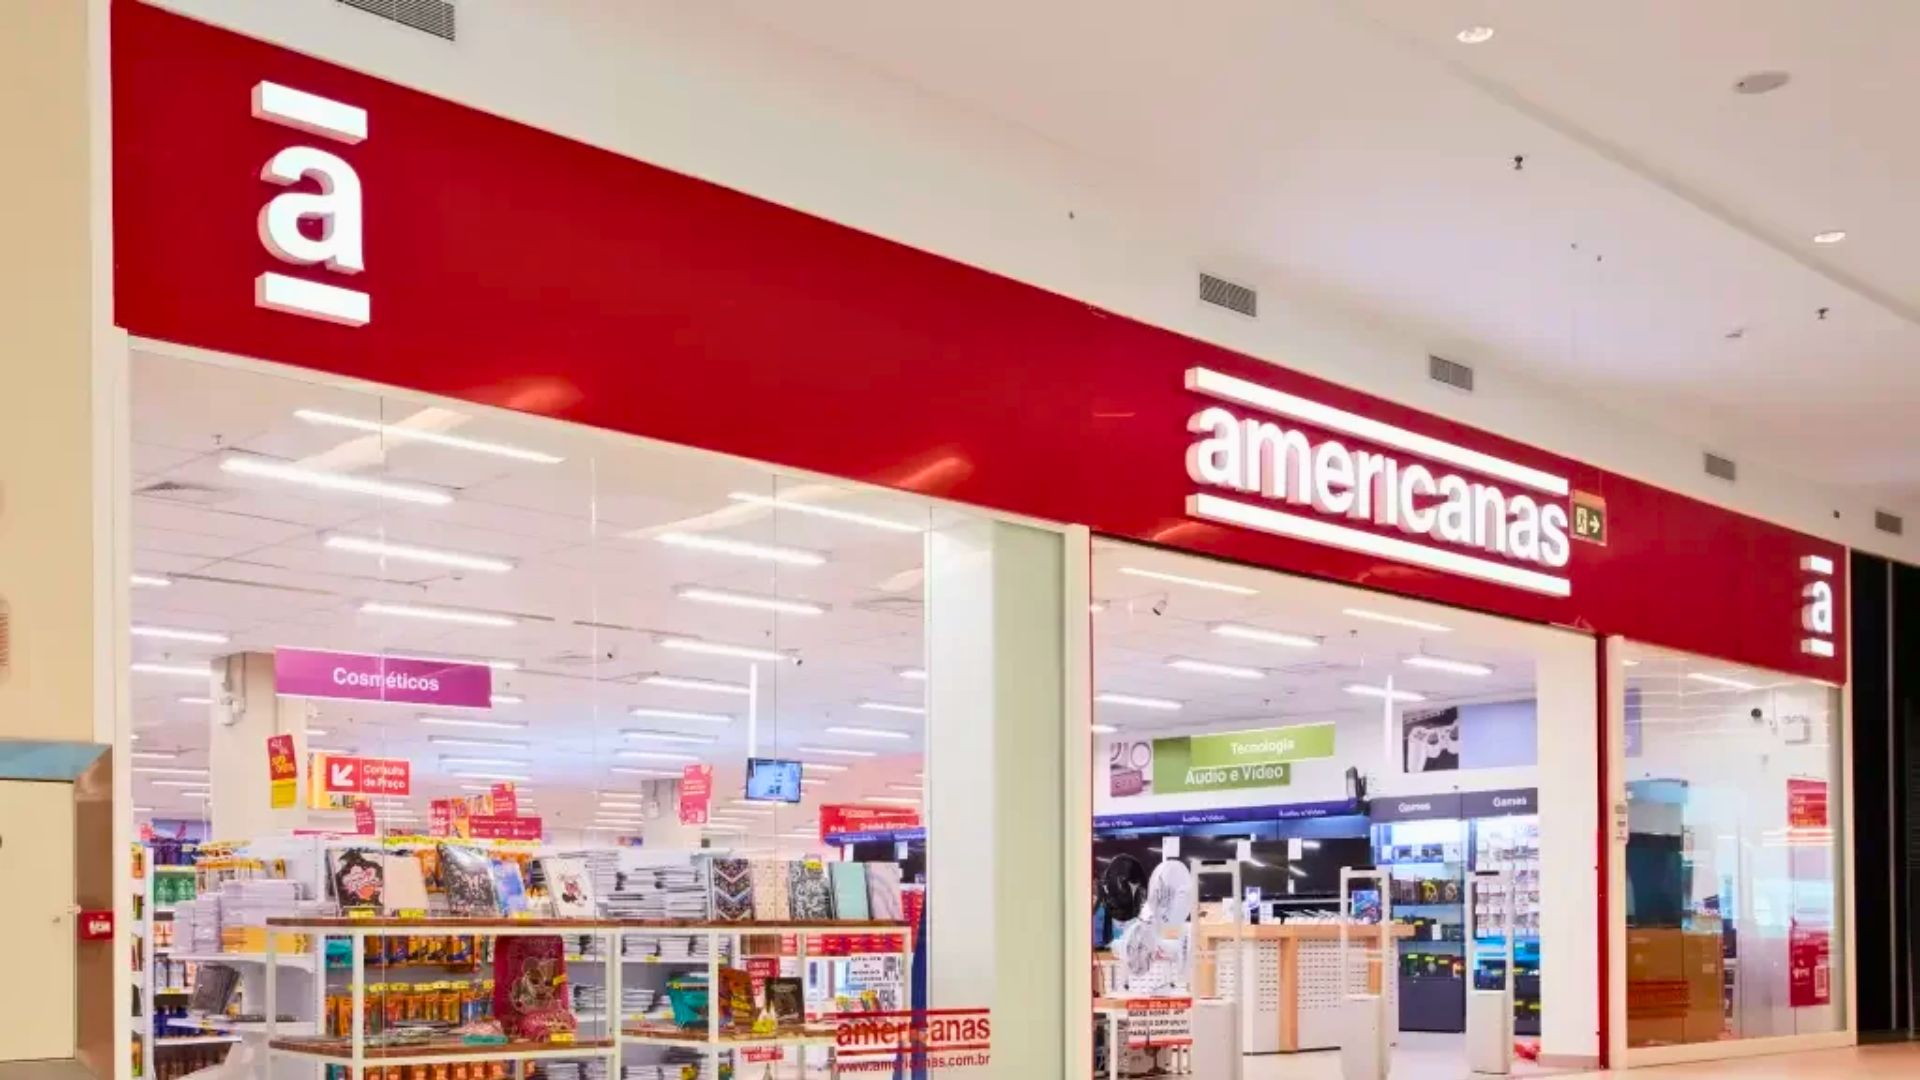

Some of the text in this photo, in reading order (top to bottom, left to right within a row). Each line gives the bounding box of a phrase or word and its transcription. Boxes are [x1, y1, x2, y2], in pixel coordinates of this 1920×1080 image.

[257, 146, 365, 276] a
[1185, 406, 1570, 567] americanas
[1801, 581, 1832, 633] a
[333, 667, 440, 691] Cosméticos
[1230, 738, 1295, 755] Tecnologia
[363, 764, 405, 776] Consulta
[1230, 770, 1239, 782] e
[1398, 802, 1431, 813] Games
[1492, 796, 1527, 807] Games
[837, 1053, 990, 1073] www.aminas.com.br
